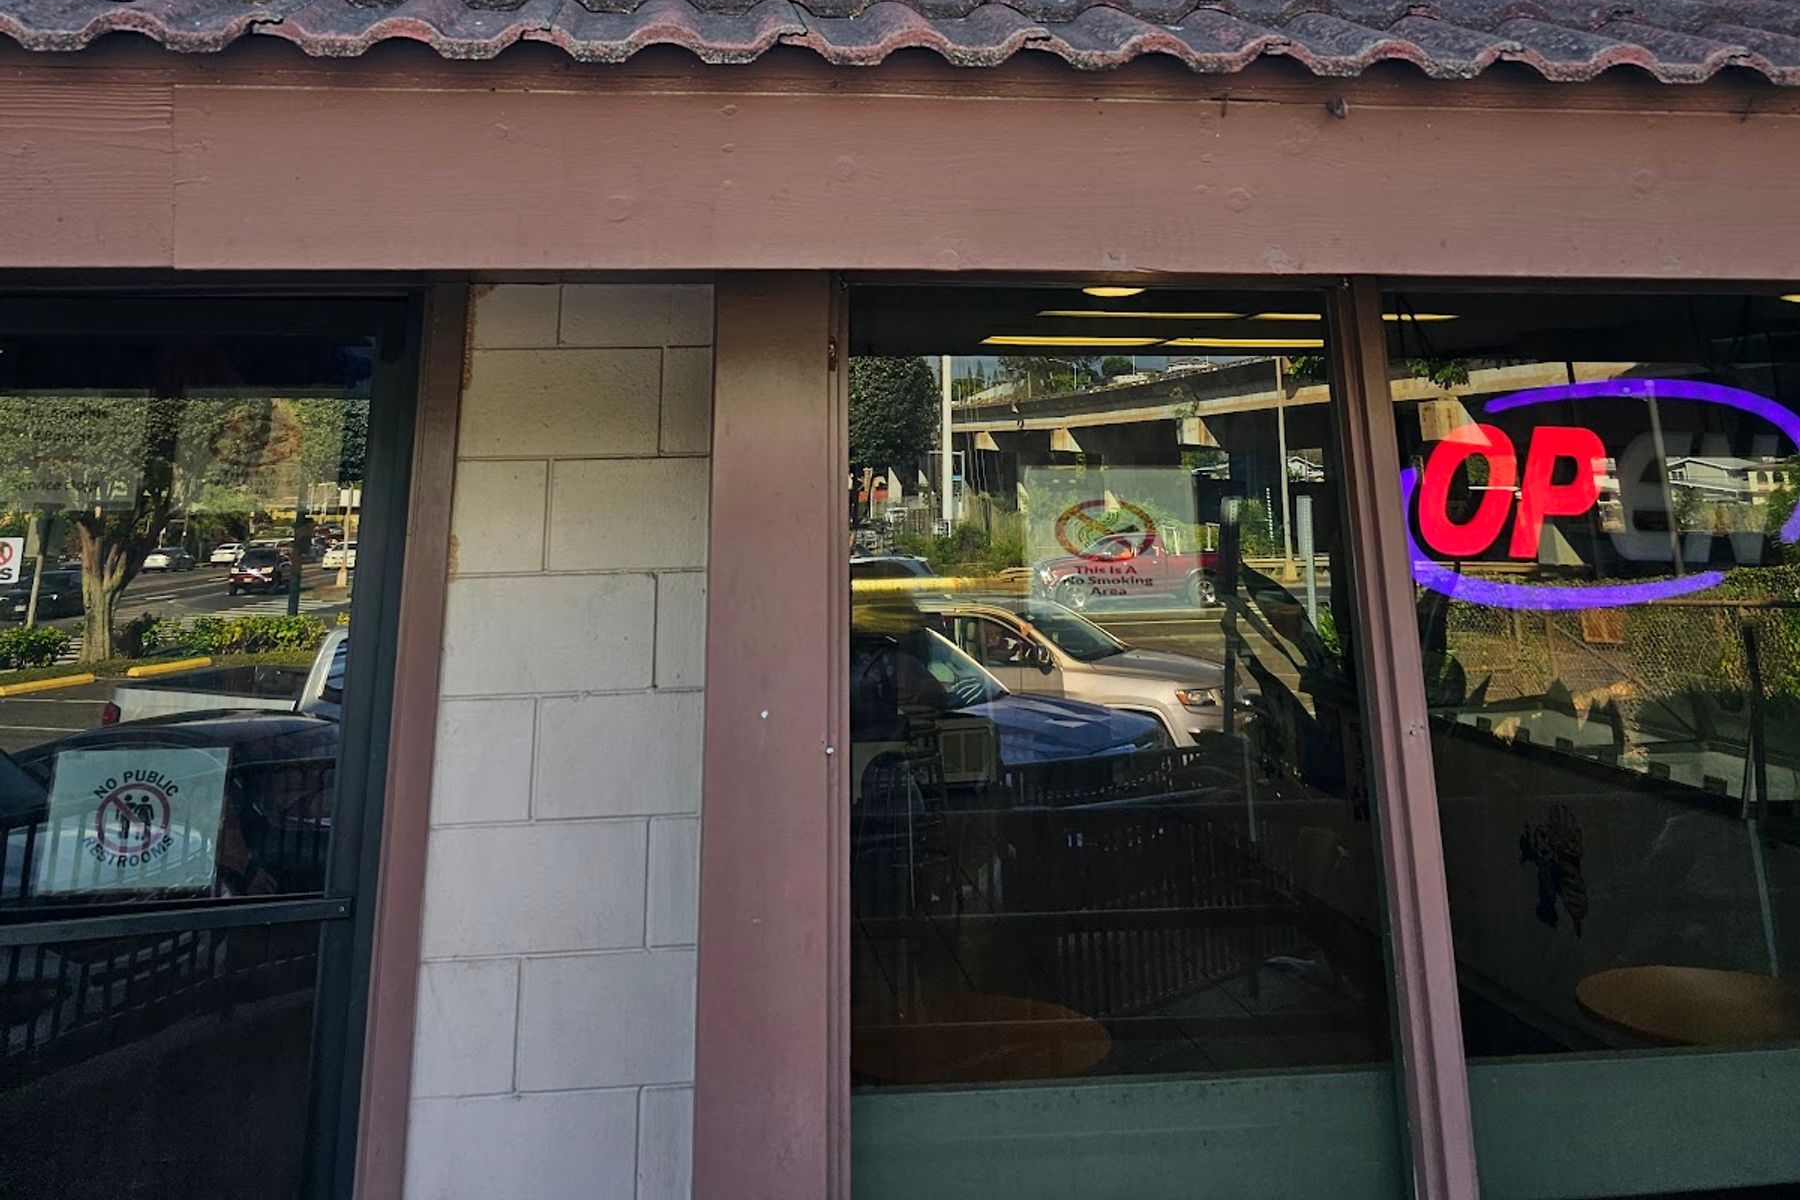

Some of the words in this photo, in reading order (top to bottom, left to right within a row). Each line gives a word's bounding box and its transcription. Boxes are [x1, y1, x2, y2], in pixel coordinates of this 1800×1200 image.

[1073, 565, 1106, 575] This
[1124, 565, 1138, 575] A
[1063, 575, 1085, 585] No
[1087, 575, 1154, 587] Smoking
[1090, 586, 1128, 596] Area
[93, 777, 117, 799] NO
[123, 769, 179, 798] PUBLIC
[83, 834, 174, 868] RESTROOMS
